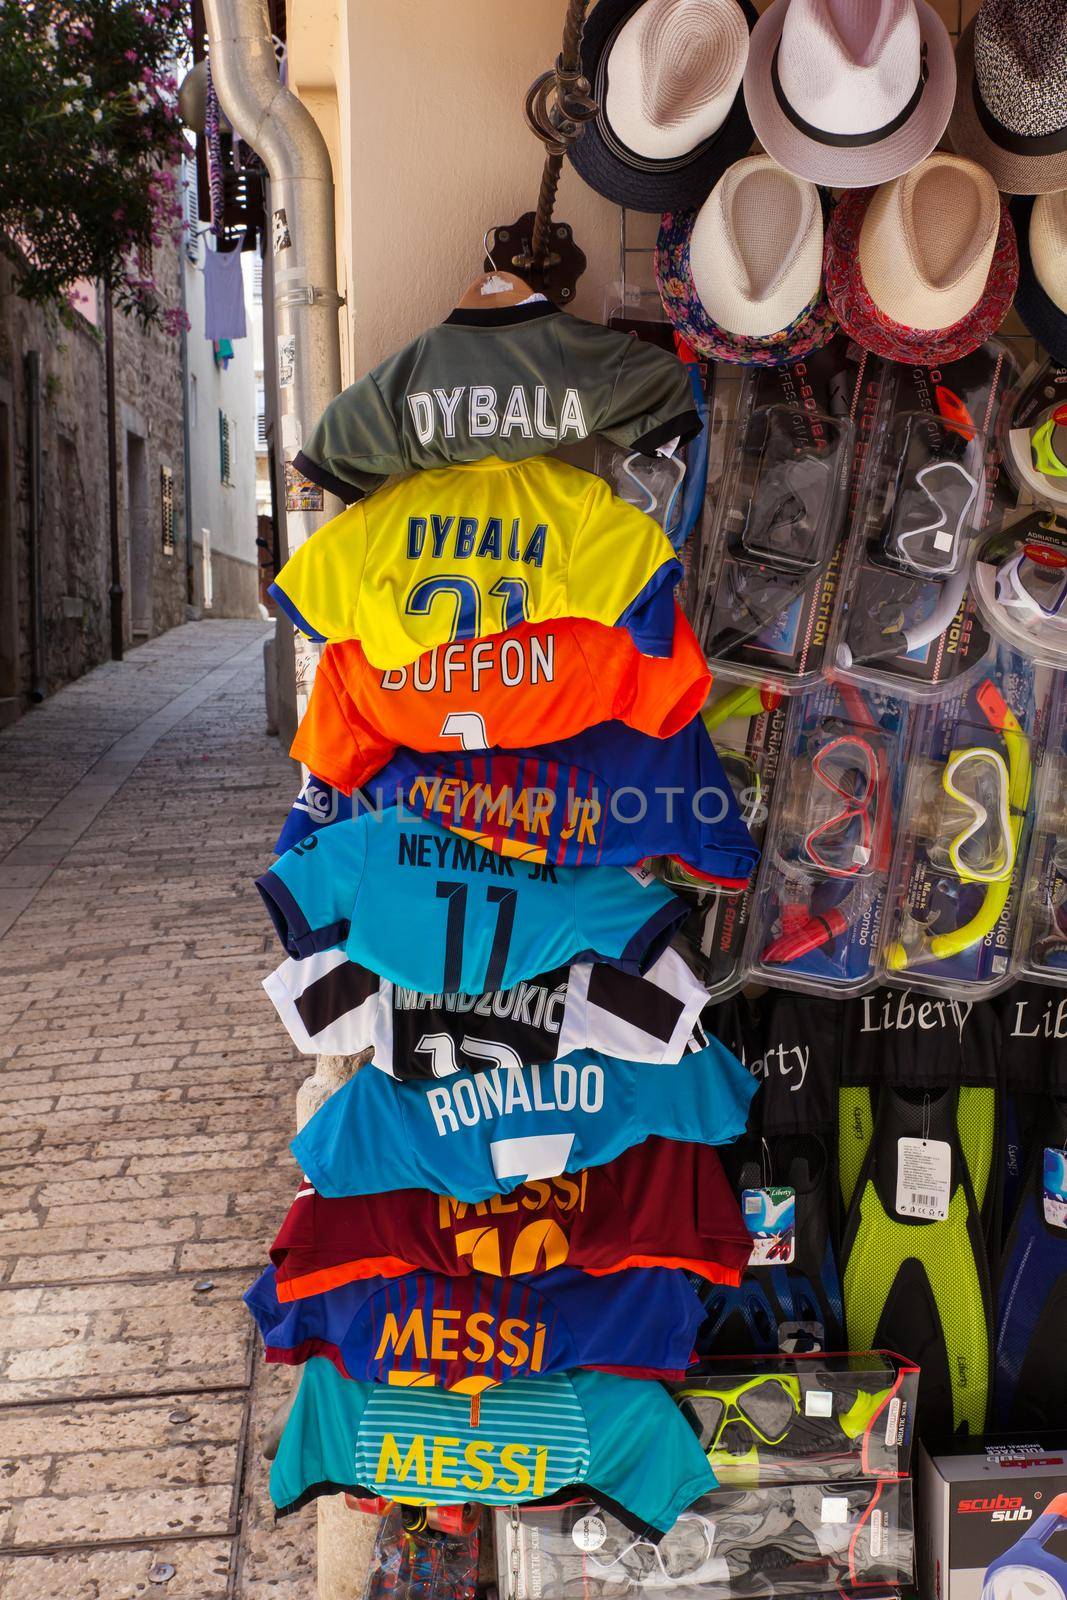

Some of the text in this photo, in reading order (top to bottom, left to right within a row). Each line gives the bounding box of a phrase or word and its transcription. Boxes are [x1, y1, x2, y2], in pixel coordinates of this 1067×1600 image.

[407, 386, 589, 446] DYBALA
[407, 513, 549, 568] DYBALA
[380, 634, 554, 692] BUFFON
[408, 776, 551, 836] NEYMAR
[560, 797, 602, 845] JR
[398, 832, 515, 877] NEYMAR
[995, 893, 1013, 950] snorkel
[742, 1043, 810, 1091] erty
[426, 1064, 604, 1136] RONALDO
[373, 1308, 547, 1373] MESSI
[374, 1433, 548, 1497] MESSI
[957, 1494, 1023, 1513] scuba
[991, 1506, 1034, 1522] sub
